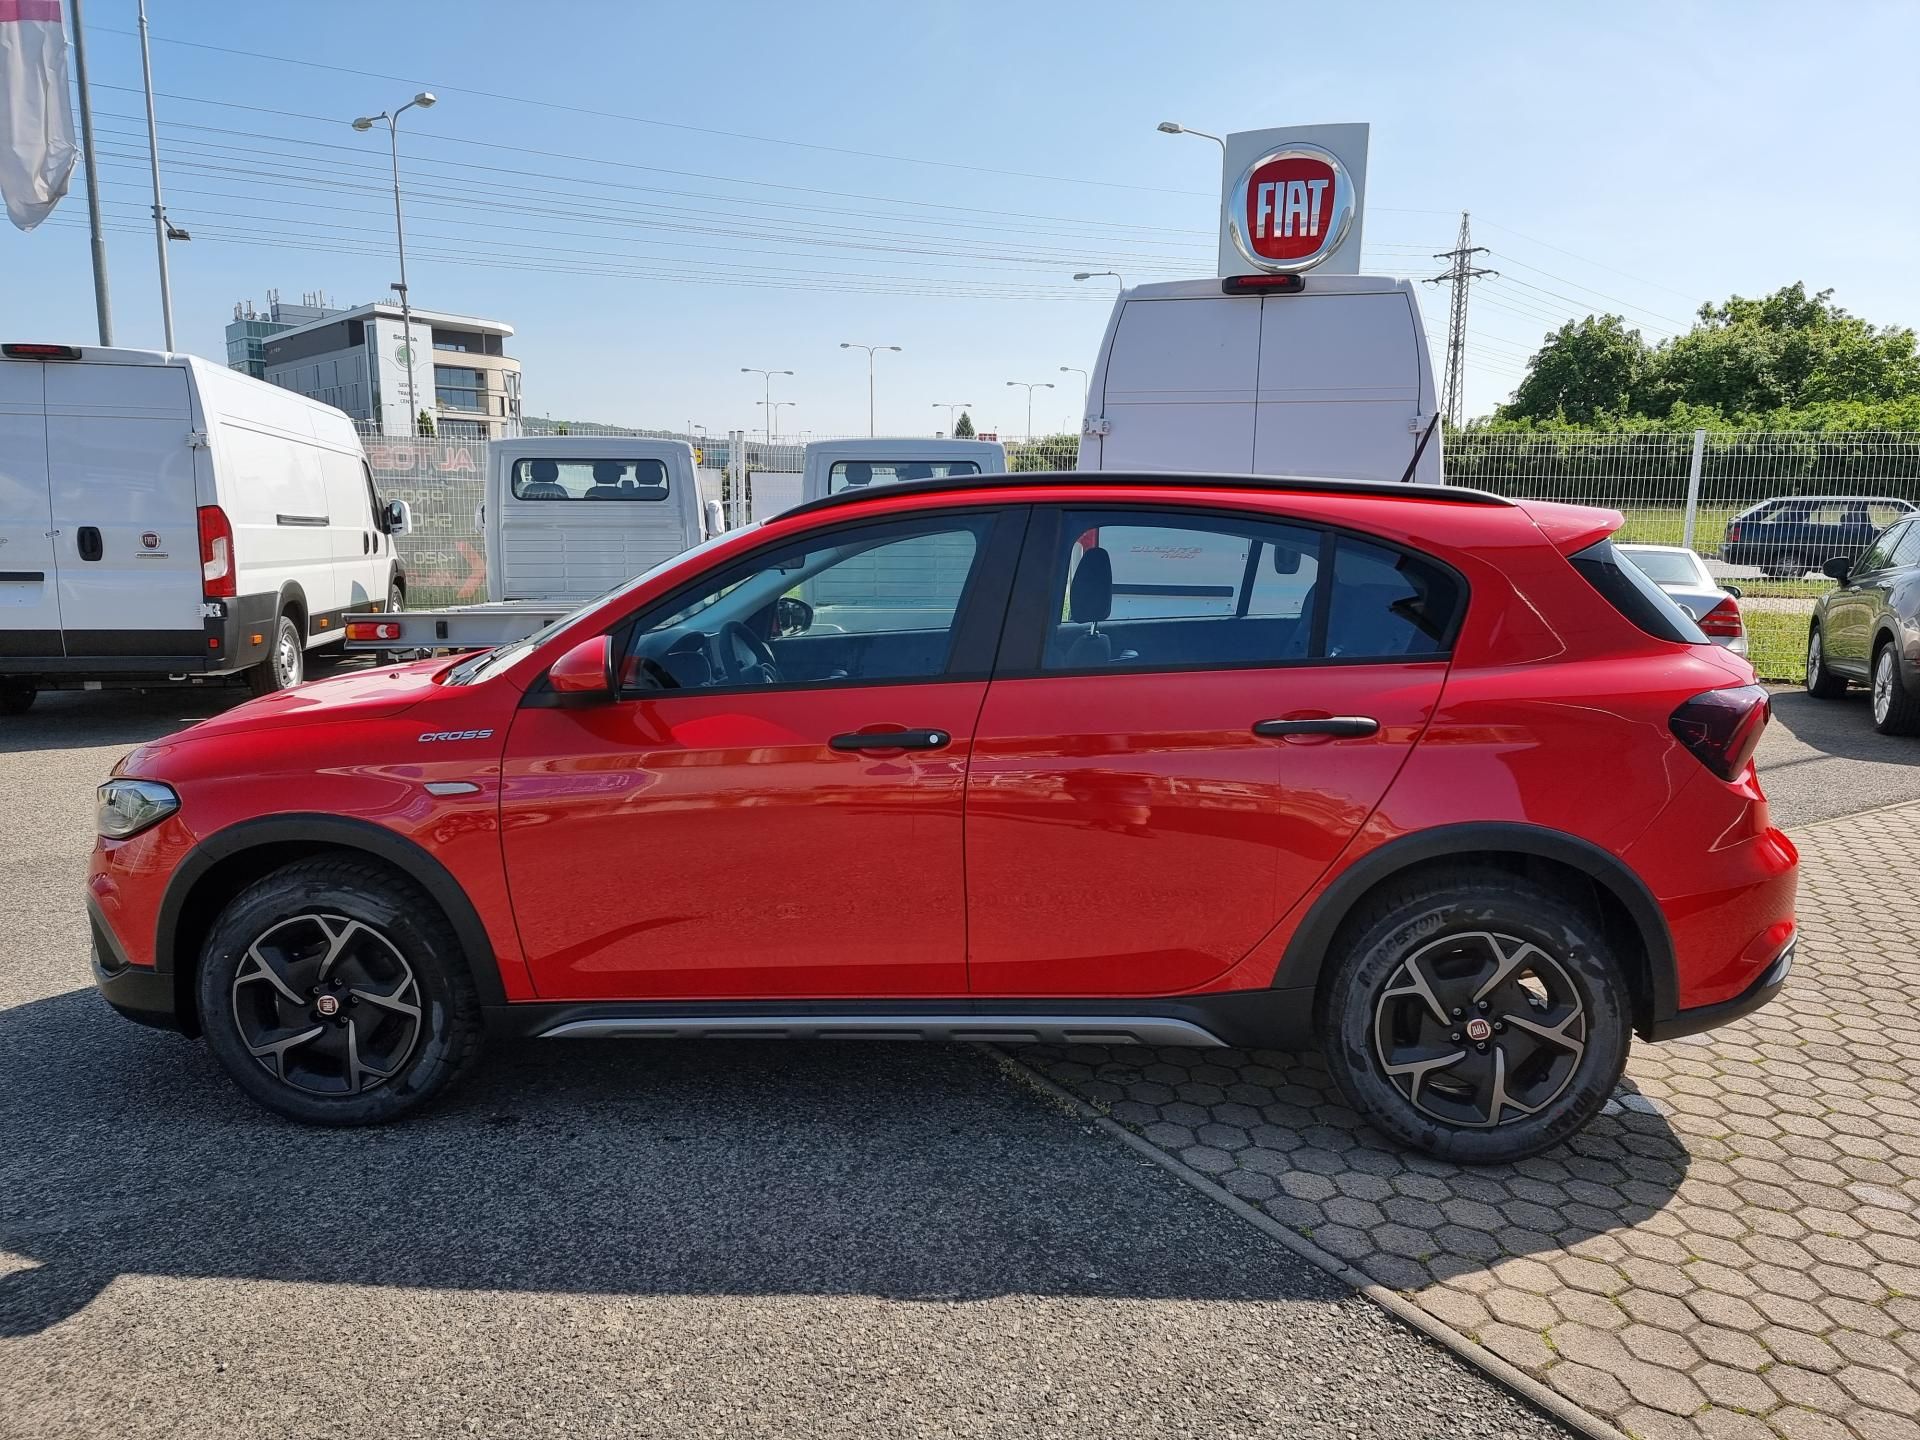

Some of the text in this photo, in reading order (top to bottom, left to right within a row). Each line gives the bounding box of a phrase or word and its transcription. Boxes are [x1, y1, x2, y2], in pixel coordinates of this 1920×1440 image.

[1256, 179, 1329, 239] FIAT
[418, 729, 494, 742] CROSS
[1471, 1024, 1486, 1036] FIAT
